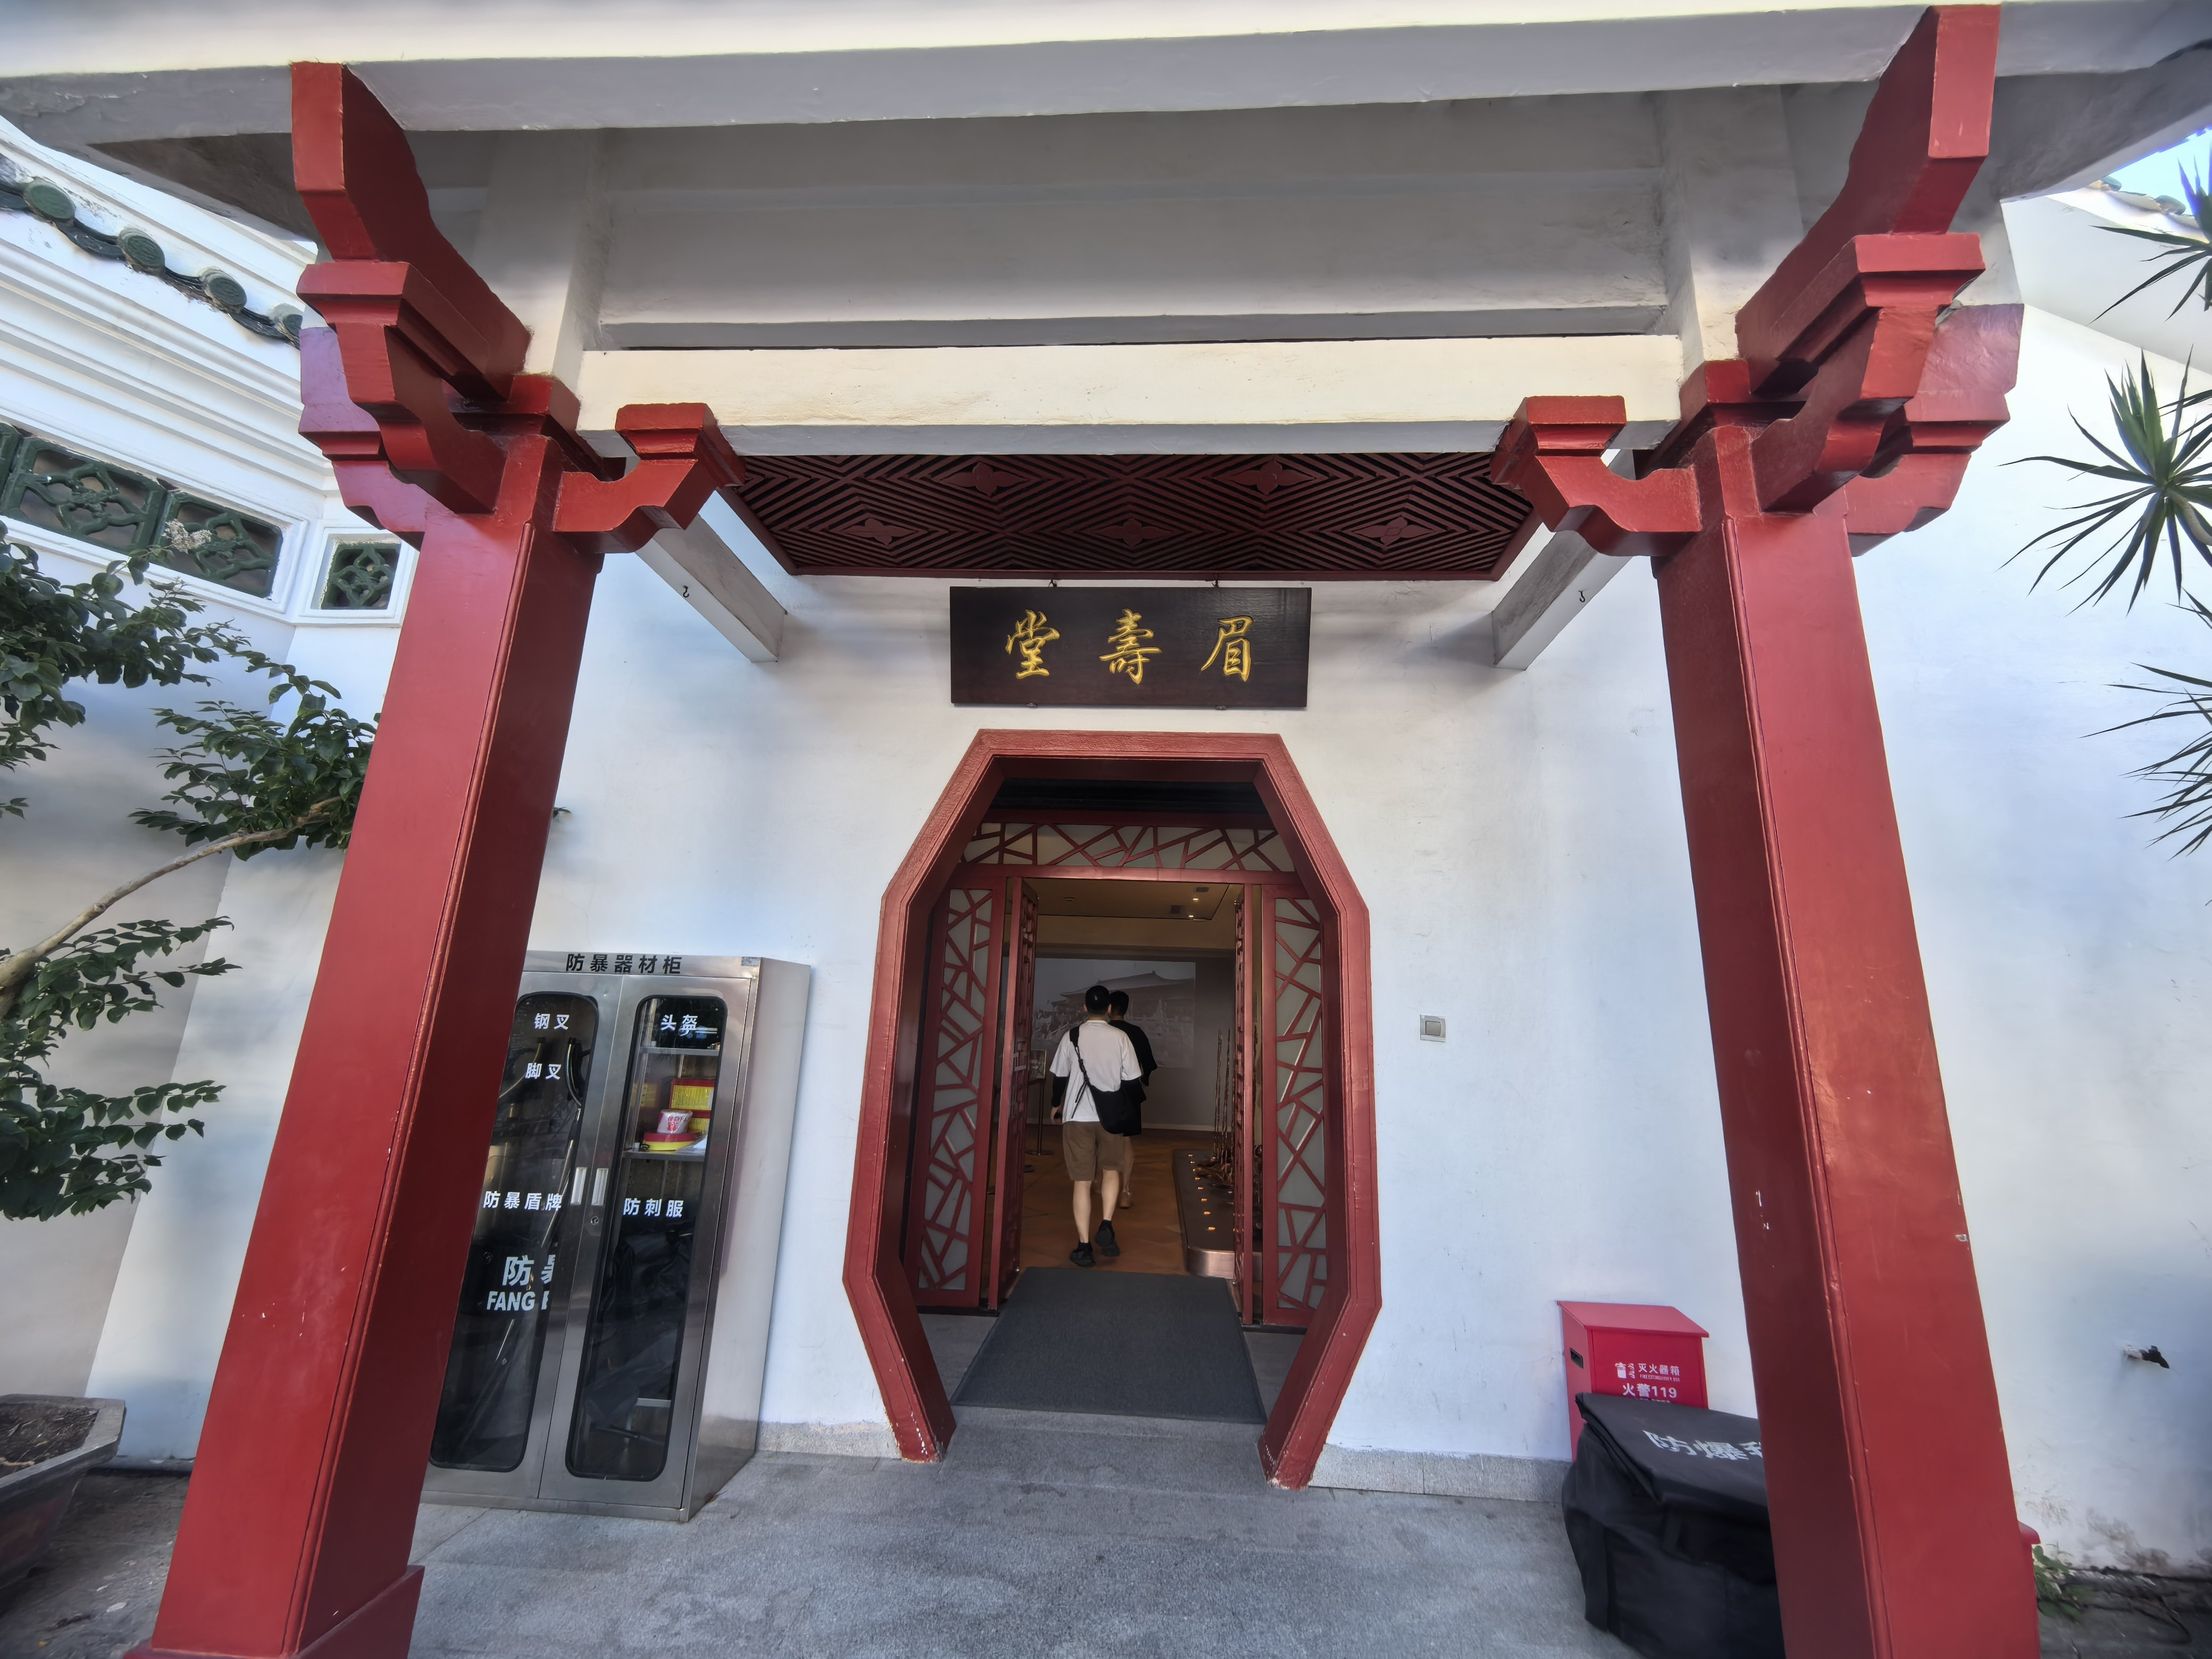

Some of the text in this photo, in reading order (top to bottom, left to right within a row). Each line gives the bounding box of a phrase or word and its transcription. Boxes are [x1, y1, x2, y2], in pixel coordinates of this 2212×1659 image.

[565, 953, 682, 975] 防暴器材柜
[534, 1012, 570, 1030] 钢叉
[660, 1014, 698, 1031] 头盔
[525, 1062, 562, 1080] 脚叉
[483, 1191, 563, 1211] 防暴盾牌
[623, 1198, 684, 1218] 防刺服
[486, 1291, 536, 1311] FANG
[1637, 1363, 1680, 1377] 灭火器箱
[1622, 1382, 1677, 1399] 火警119
